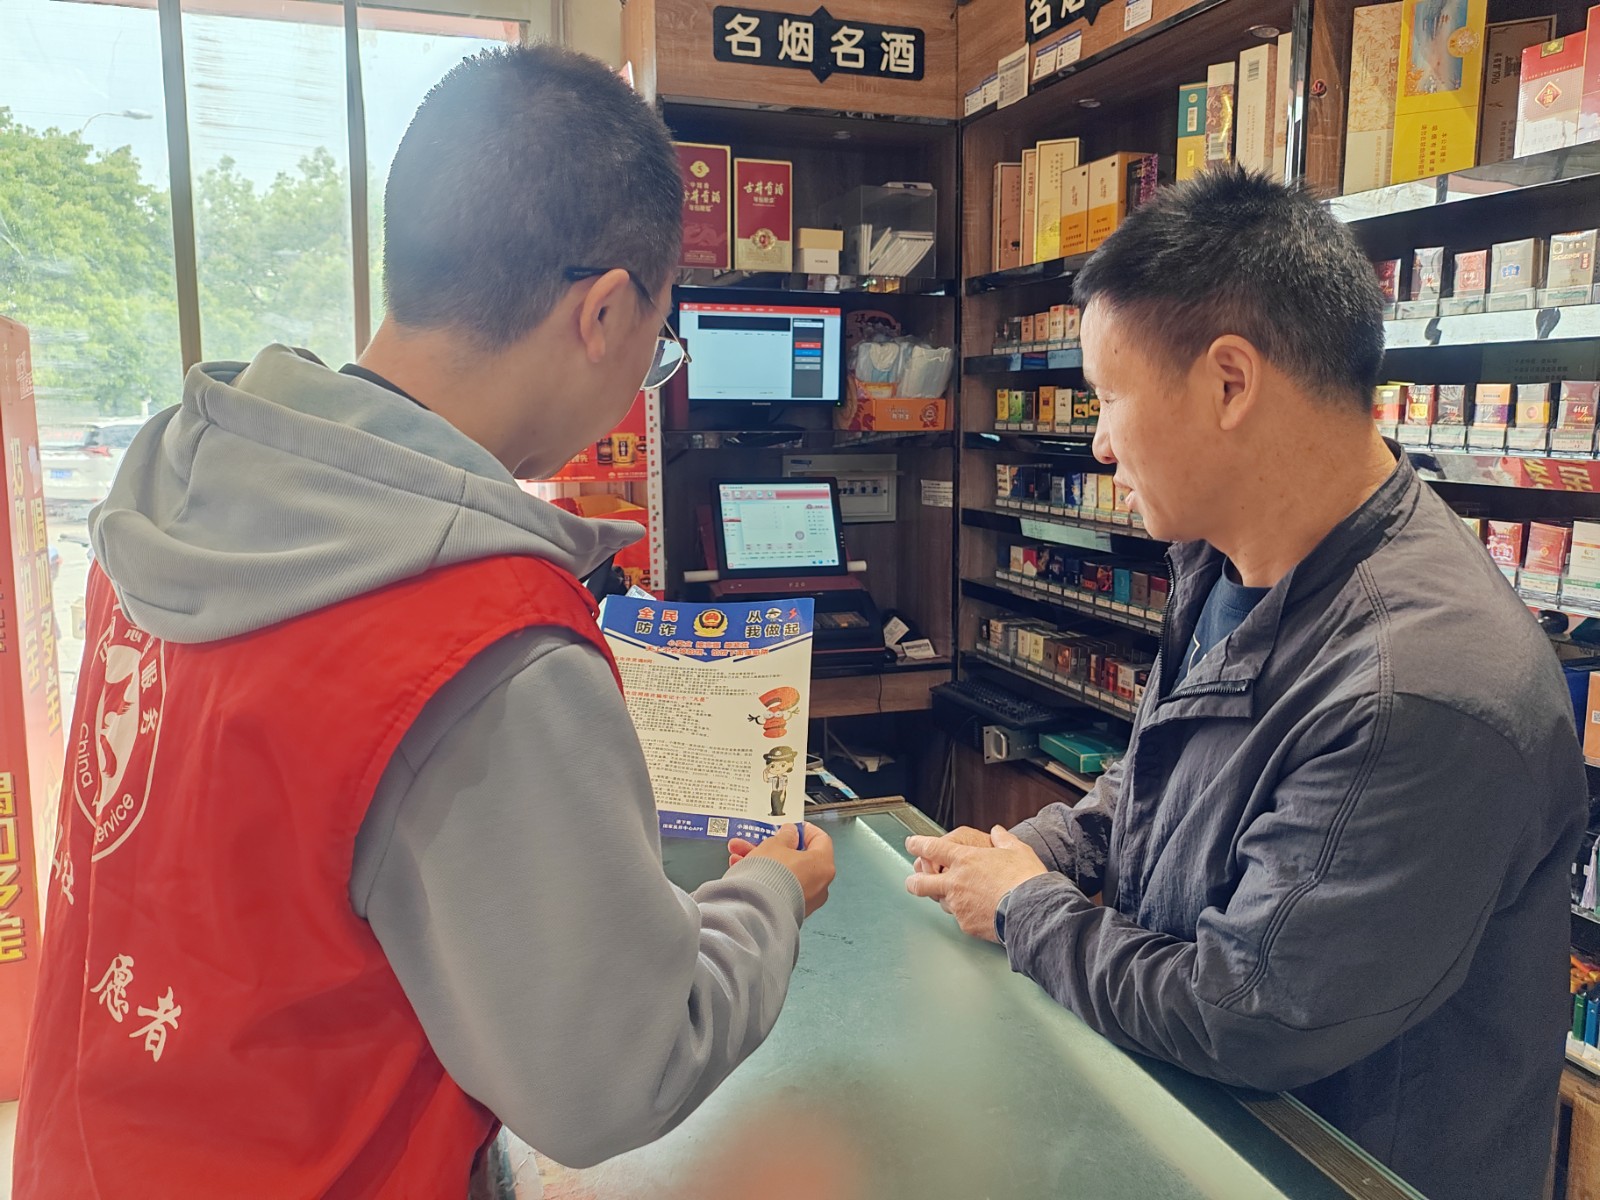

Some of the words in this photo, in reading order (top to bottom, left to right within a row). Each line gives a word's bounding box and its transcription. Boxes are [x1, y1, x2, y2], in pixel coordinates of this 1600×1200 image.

[723, 13, 916, 75] 名烟名酒
[743, 180, 784, 196] 古井贡酒
[637, 606, 680, 622] 全民
[745, 609, 763, 624] 从
[635, 622, 677, 637] 防诈
[745, 623, 801, 638] 我做起
[77, 722, 94, 789] China
[94, 792, 134, 845] ervice
